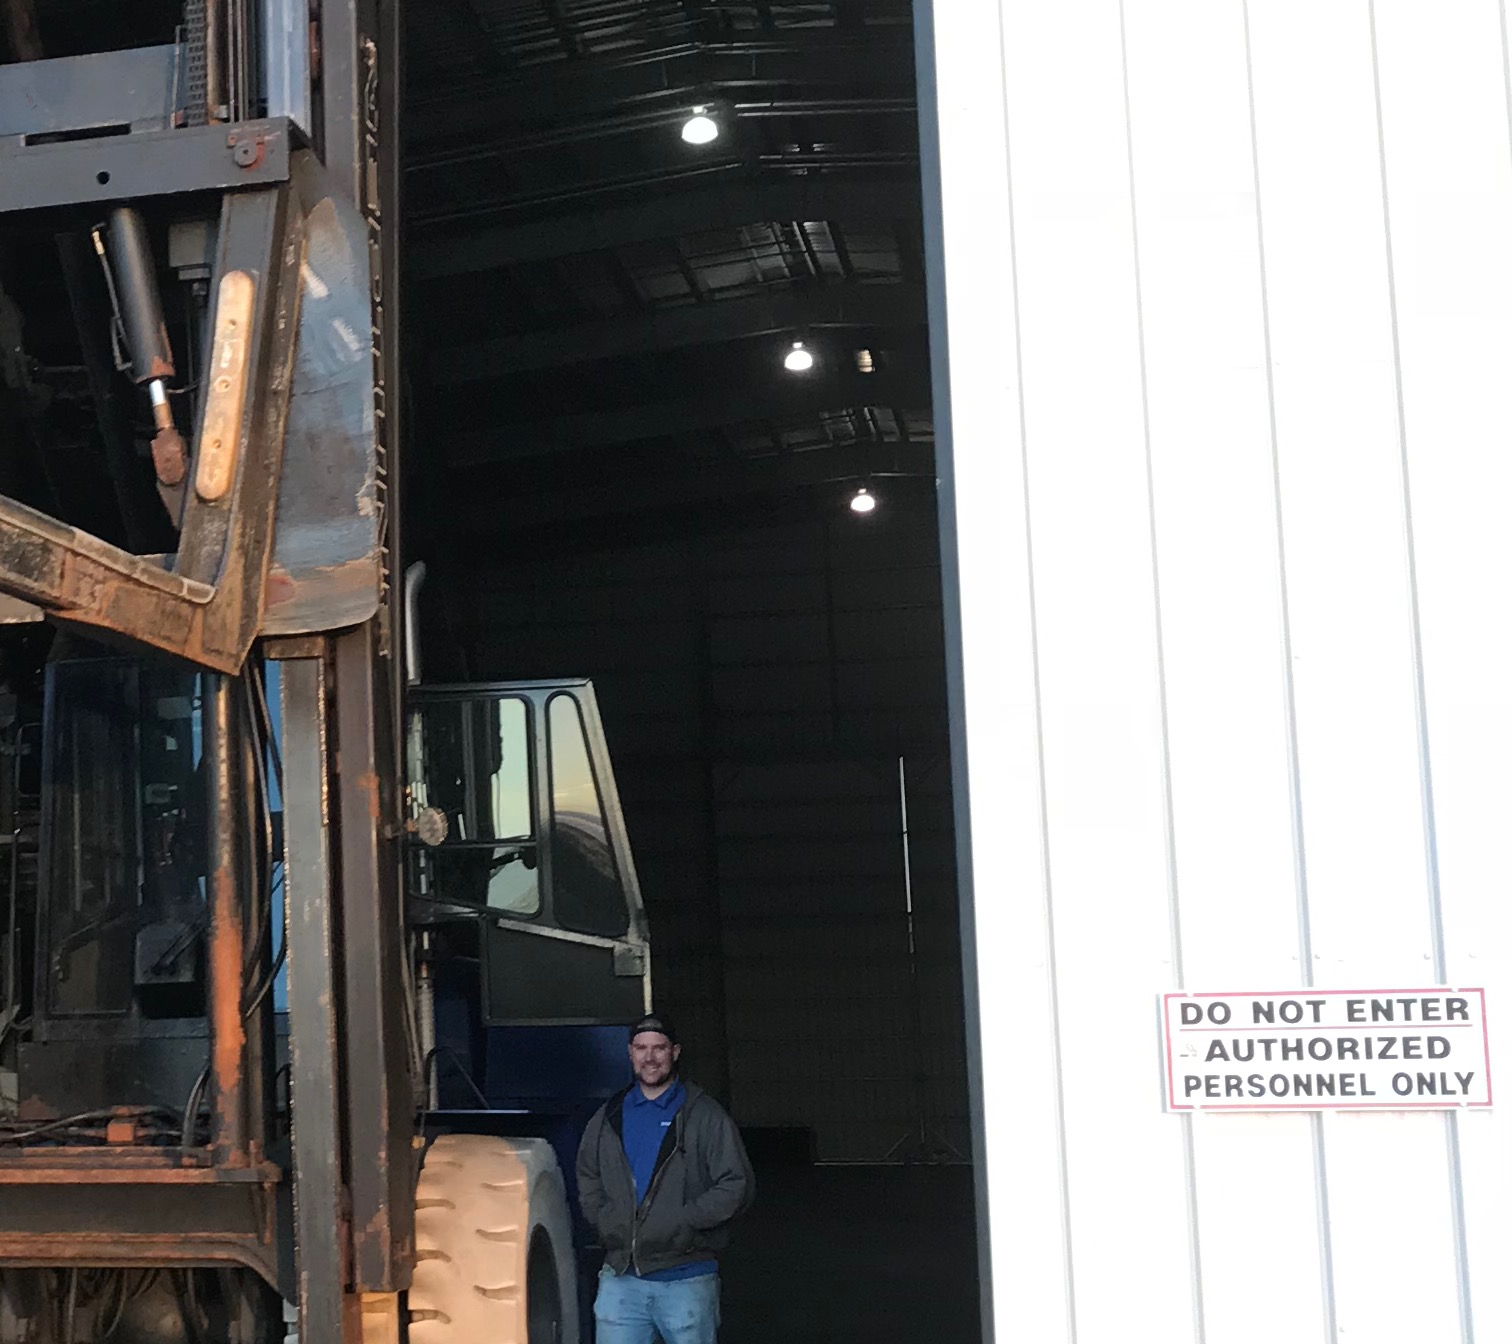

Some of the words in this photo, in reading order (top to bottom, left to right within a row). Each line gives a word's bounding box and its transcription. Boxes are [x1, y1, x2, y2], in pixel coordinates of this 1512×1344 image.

[1179, 1000, 1232, 1026] DO
[1252, 999, 1326, 1024] NOT
[1346, 996, 1470, 1022] ENTER
[1204, 1035, 1452, 1063] AUTHORIZED
[1183, 1072, 1376, 1098] PERSONNEL
[1391, 1071, 1475, 1096] ONLY
